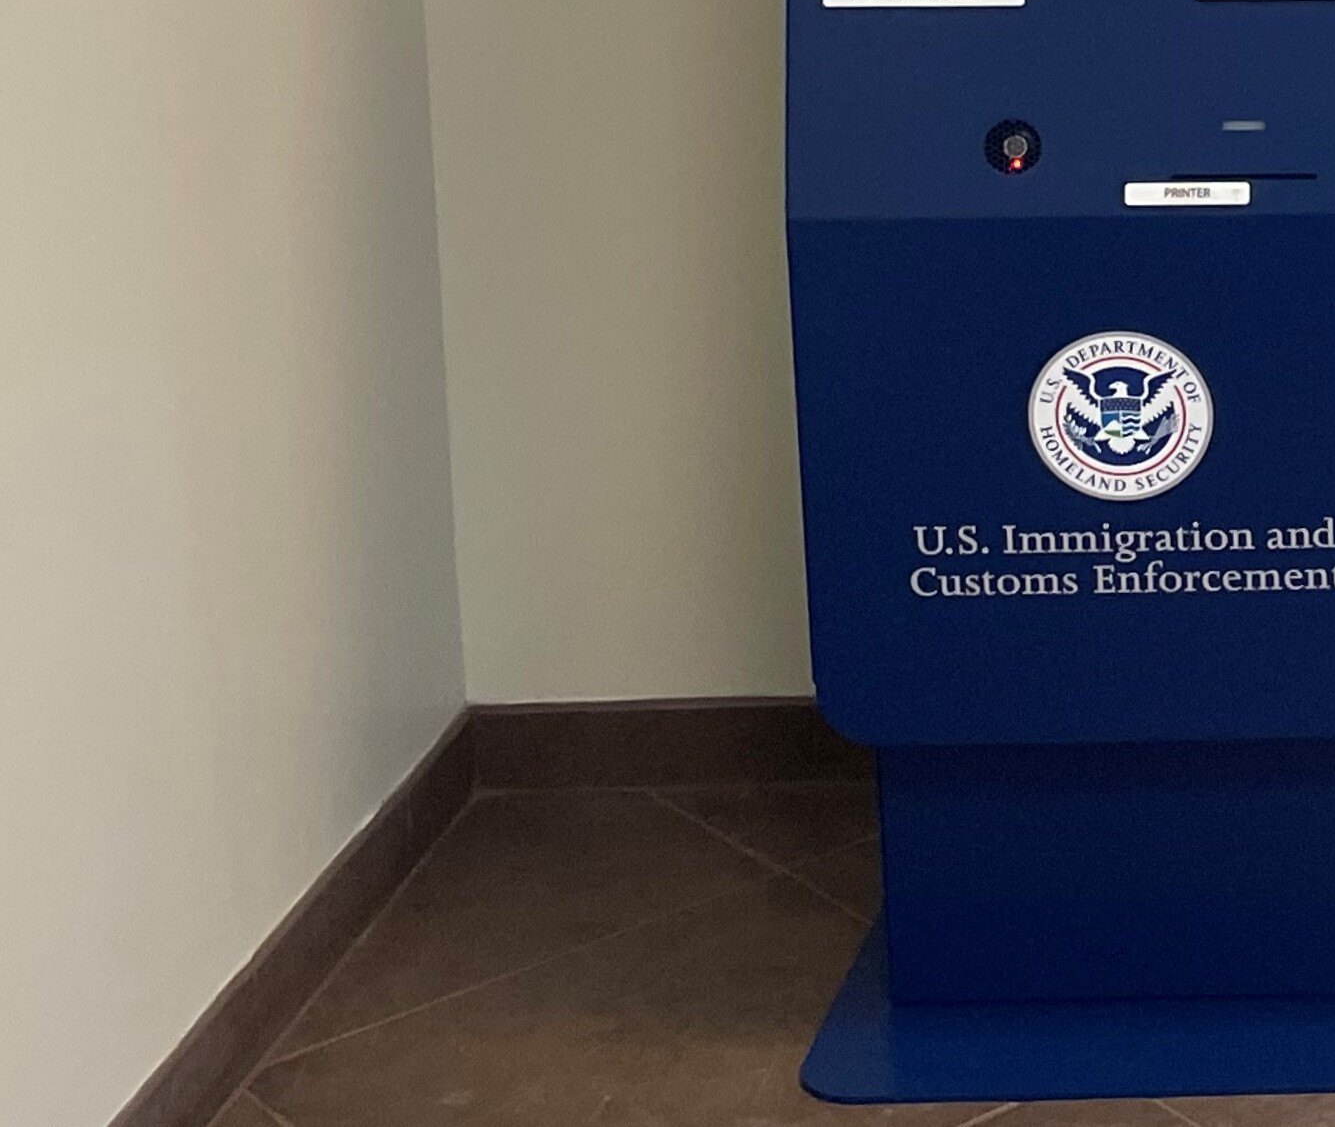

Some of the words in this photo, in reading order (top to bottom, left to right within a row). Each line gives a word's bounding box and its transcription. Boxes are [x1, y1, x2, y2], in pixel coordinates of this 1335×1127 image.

[1164, 187, 1211, 198] PRINTER
[1040, 377, 1062, 403] U.S.
[1066, 340, 1186, 380] DEPARTMENT
[1183, 381, 1202, 403] OF
[1039, 425, 1126, 492] HOMELAND
[1135, 423, 1203, 491] SECURITY
[913, 525, 989, 556] U.S.
[1002, 522, 1255, 564] Immigration
[910, 565, 1078, 597] Customs
